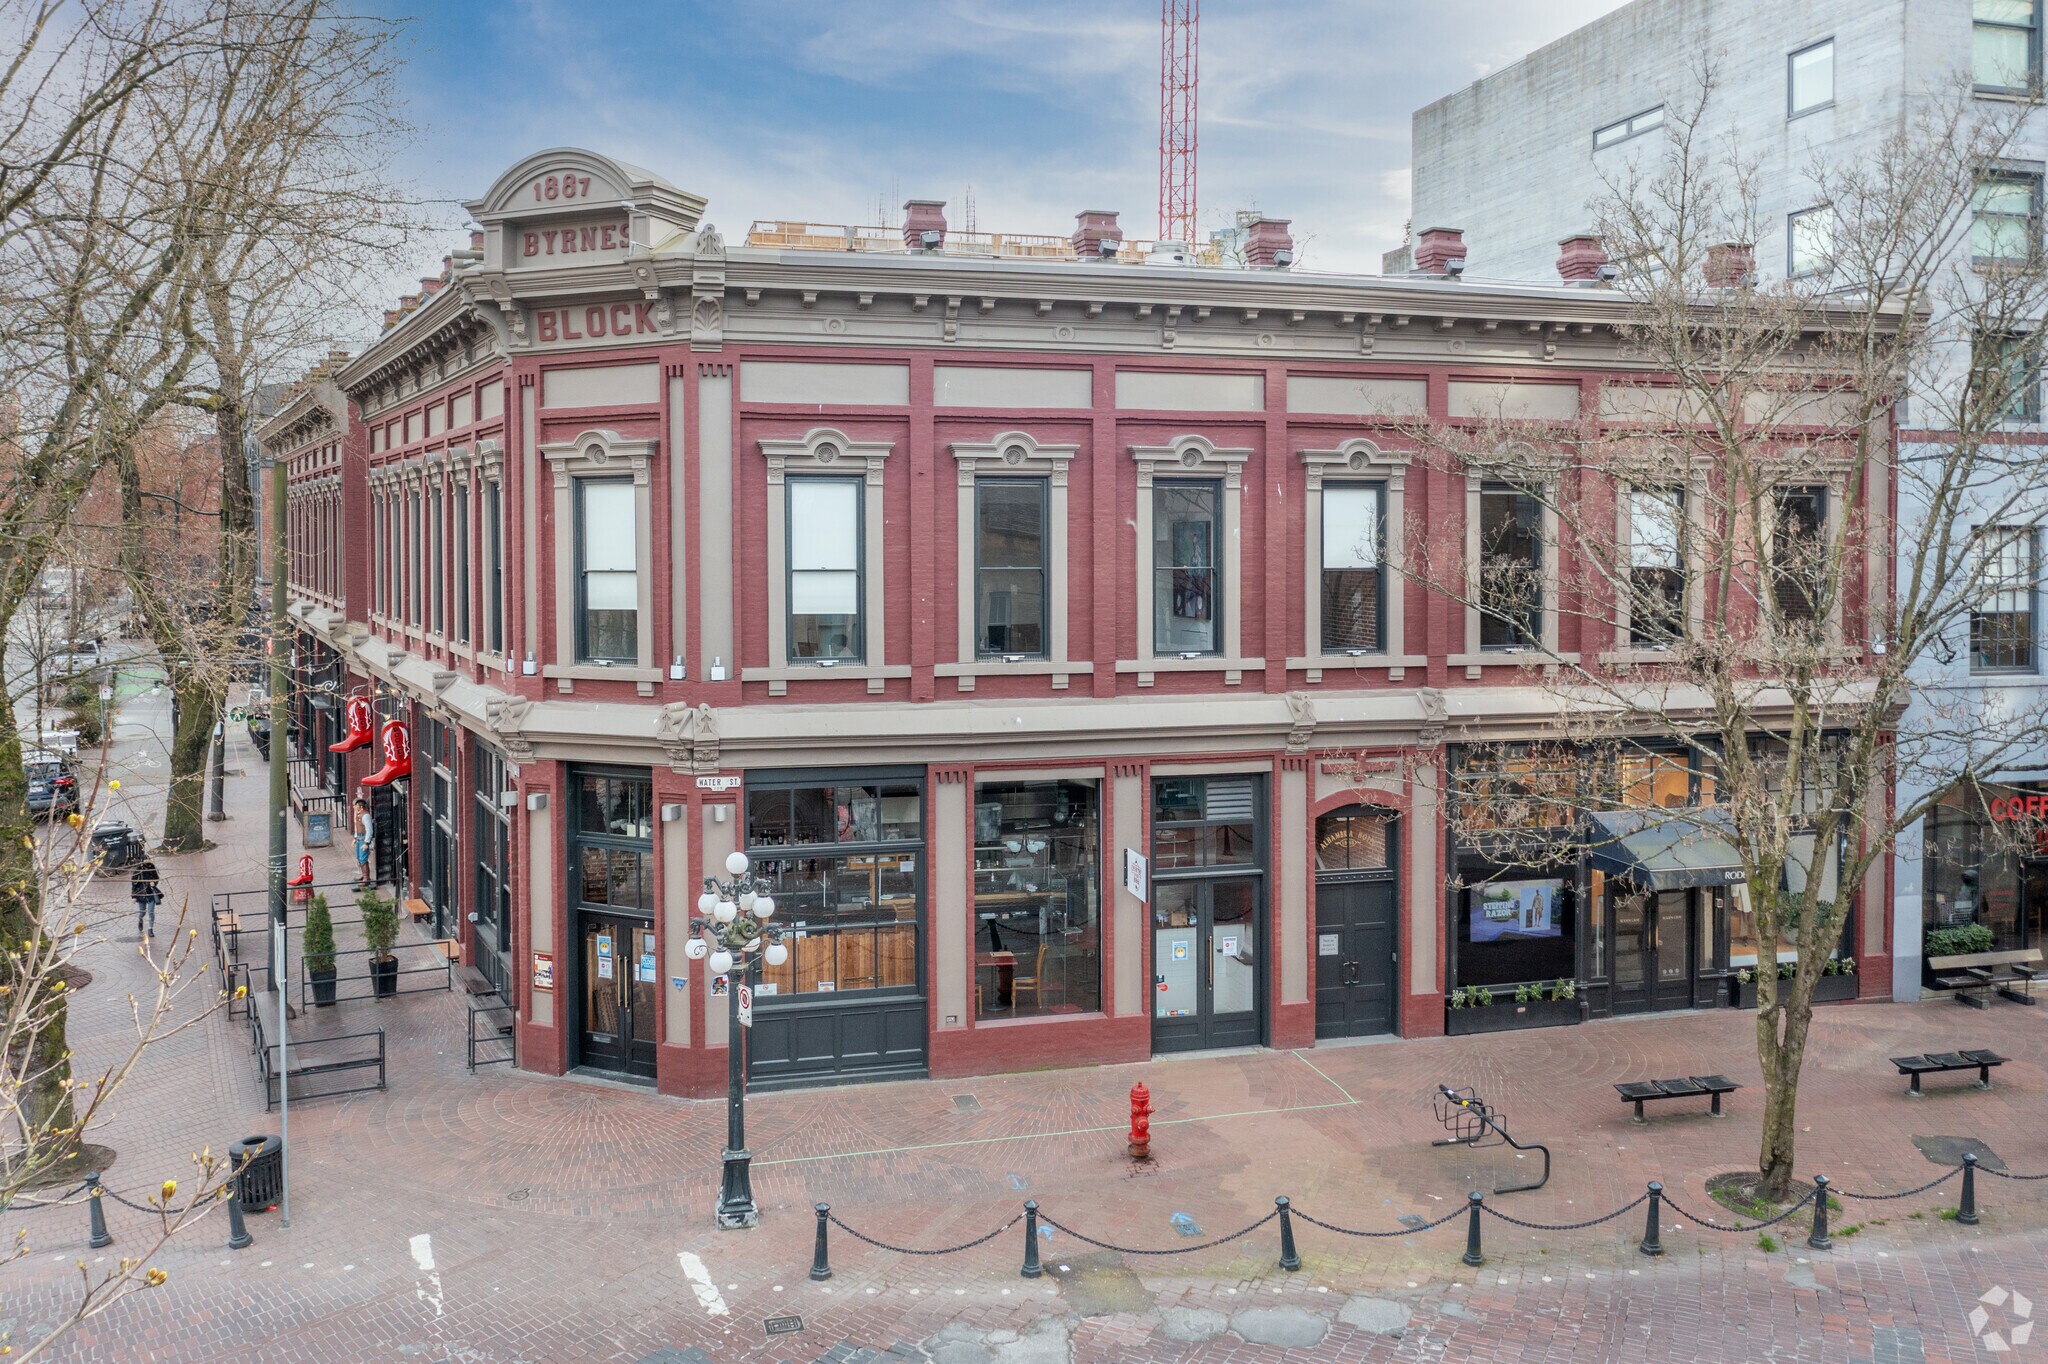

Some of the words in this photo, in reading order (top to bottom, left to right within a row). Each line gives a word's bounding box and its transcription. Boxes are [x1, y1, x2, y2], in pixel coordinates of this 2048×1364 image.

[534, 173, 591, 201] 1887
[523, 223, 629, 257] BYRNES
[537, 302, 657, 342] BLOCK
[1486, 909, 1512, 918] RAZOR
